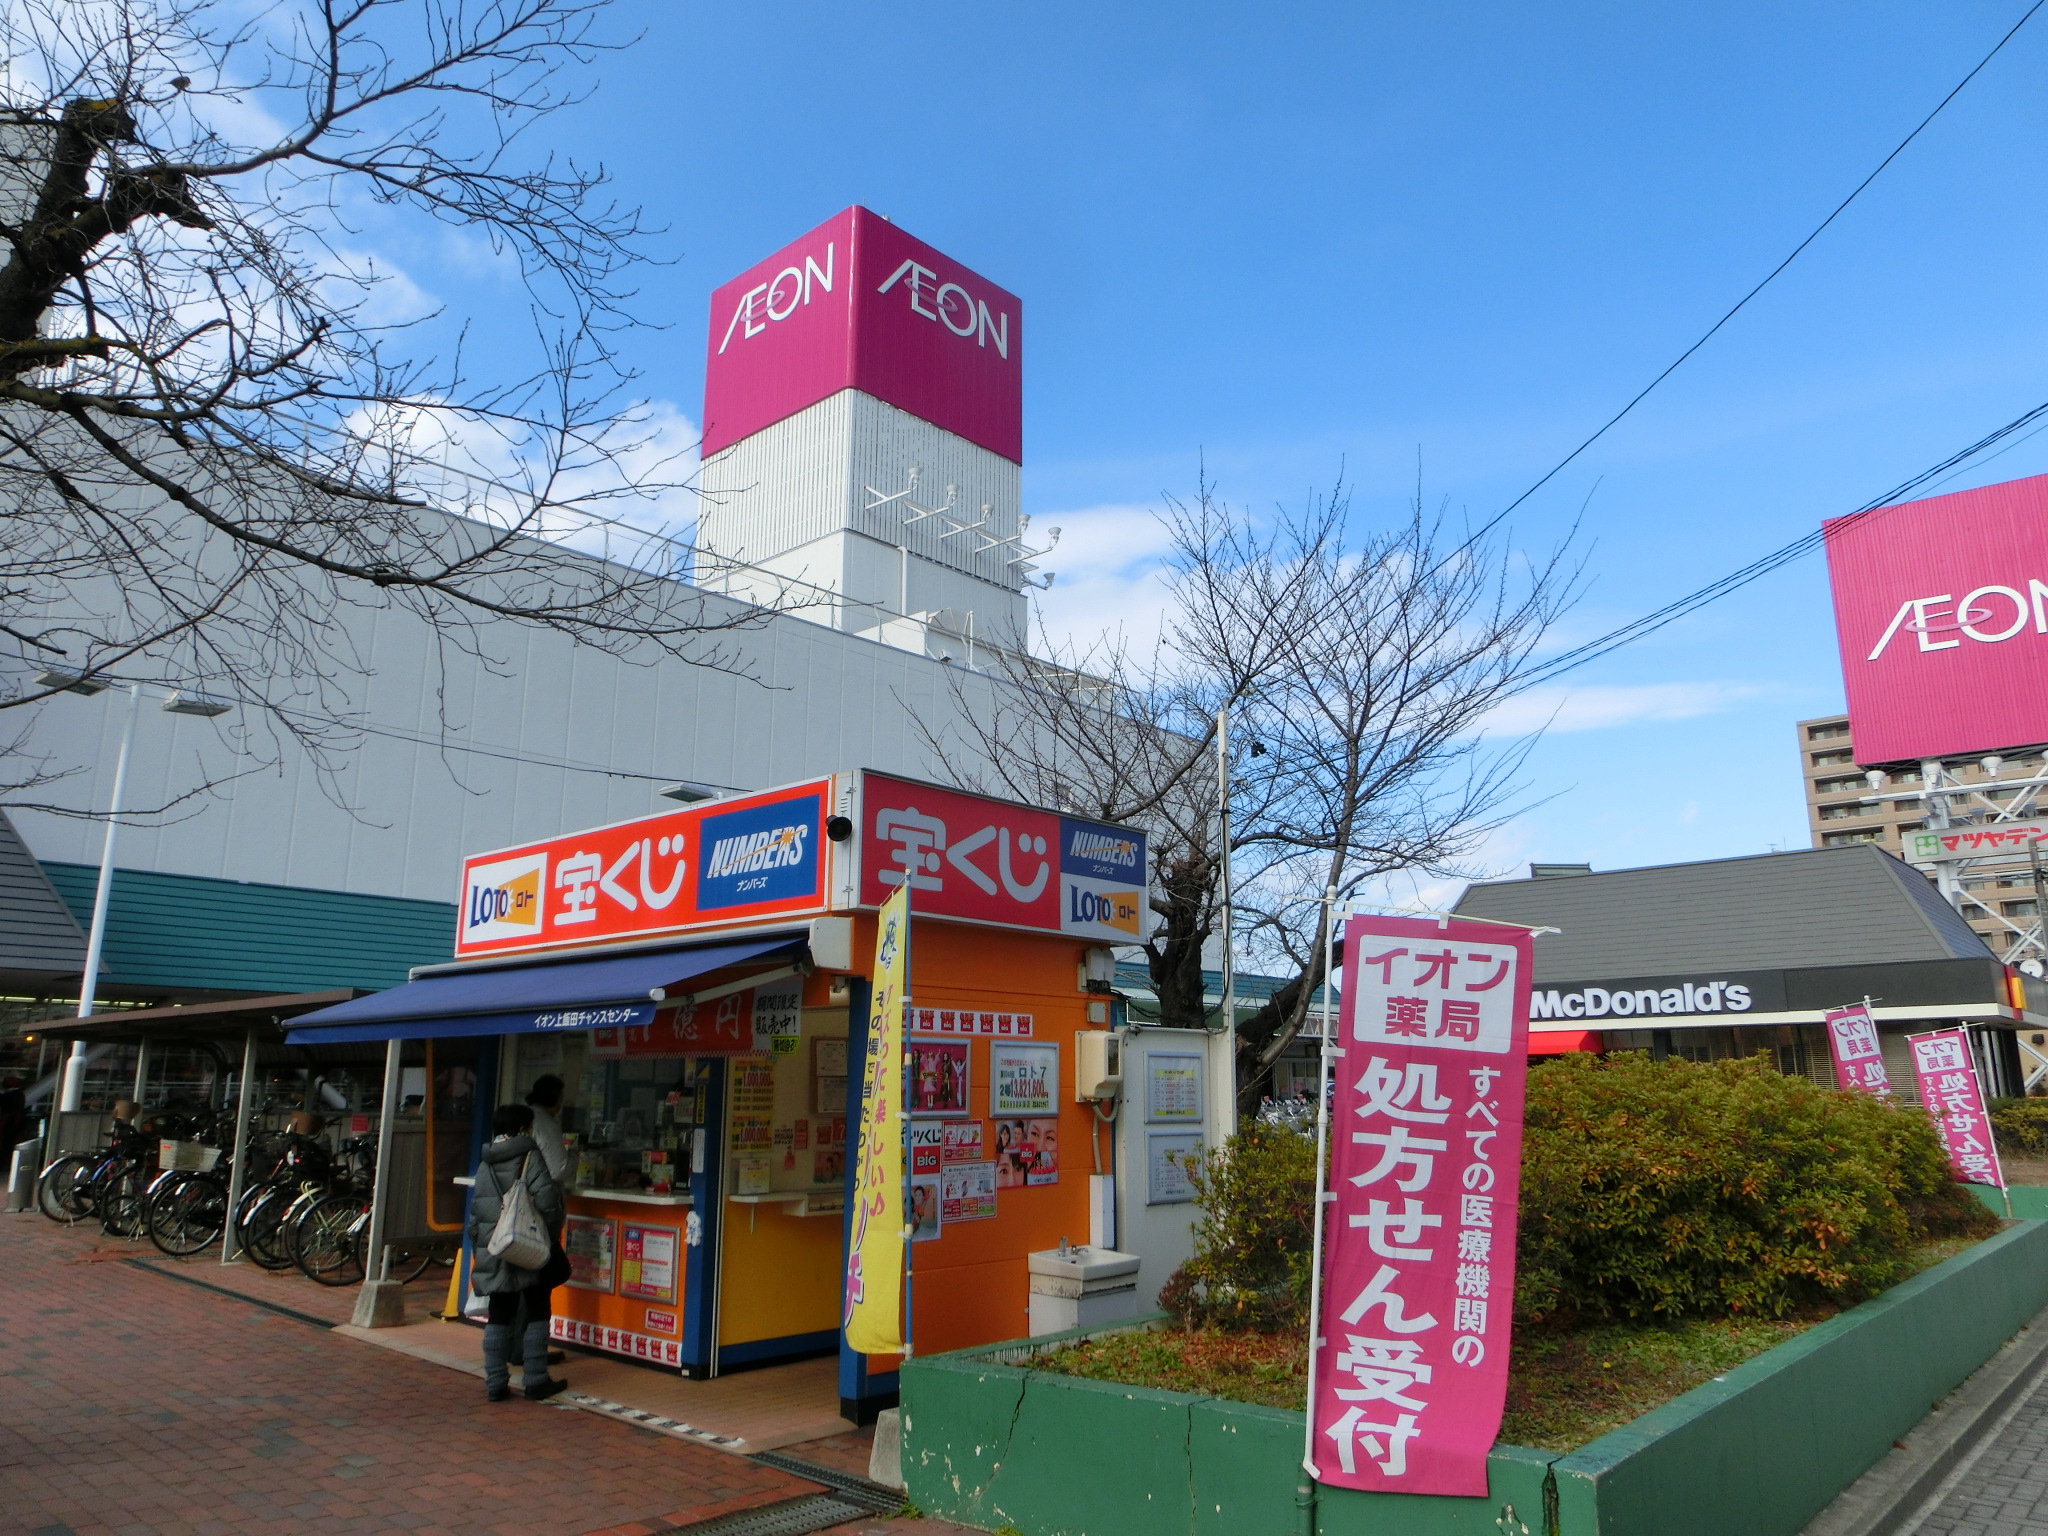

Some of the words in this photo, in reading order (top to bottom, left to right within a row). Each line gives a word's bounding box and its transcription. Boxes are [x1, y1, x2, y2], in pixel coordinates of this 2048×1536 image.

[707, 824, 808, 879] NUMBERS
[875, 807, 1050, 903] 宝くじ
[1070, 830, 1138, 868] NUMBERS
[554, 833, 686, 926] 宝くじ
[736, 876, 768, 892] ナンバーズ
[1093, 864, 1115, 876] ナンバーズ
[469, 885, 508, 929] LOTO
[516, 888, 534, 909] ロト
[1071, 884, 1111, 923] LOTO
[1119, 905, 1136, 920] ロト
[1365, 948, 1510, 992] イオン
[534, 1008, 639, 1028] イオン上飯田チャンスセンター
[756, 994, 798, 1011] 期間限定
[1384, 996, 1480, 1042] 薬局
[1530, 981, 1752, 1019] McDonald's
[917, 1151, 937, 1166] BIG
[1452, 1066, 1501, 1367] すべての医療機関の
[1325, 1056, 1453, 1476] 処方せん受付
